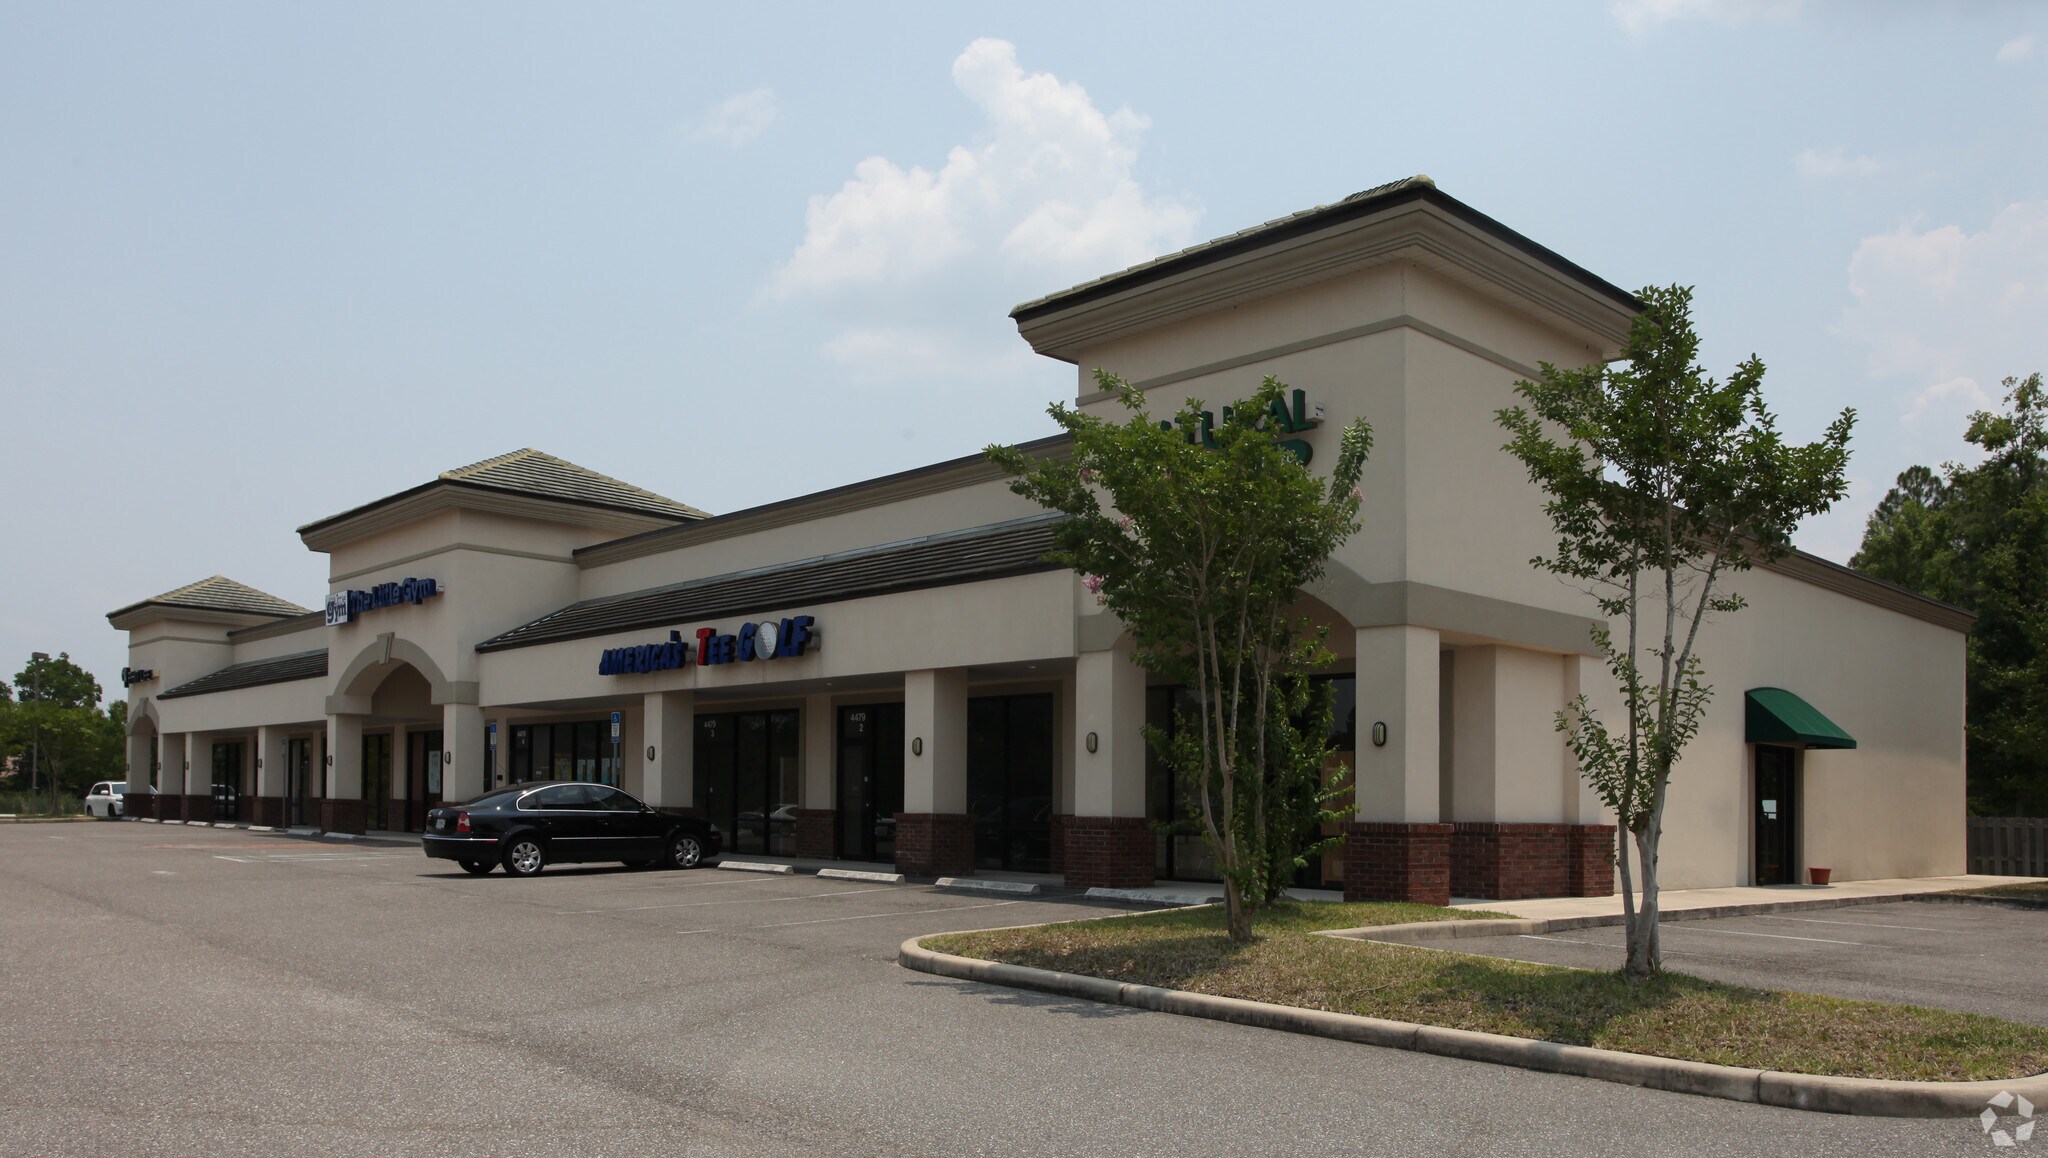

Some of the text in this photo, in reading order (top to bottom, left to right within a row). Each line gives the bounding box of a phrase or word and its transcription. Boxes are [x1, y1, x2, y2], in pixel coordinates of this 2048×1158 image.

[349, 590, 373, 613] The
[371, 582, 402, 609] Little
[402, 577, 437, 605] Gym
[598, 629, 689, 676] AMERICA'S
[850, 712, 866, 722] 4479
